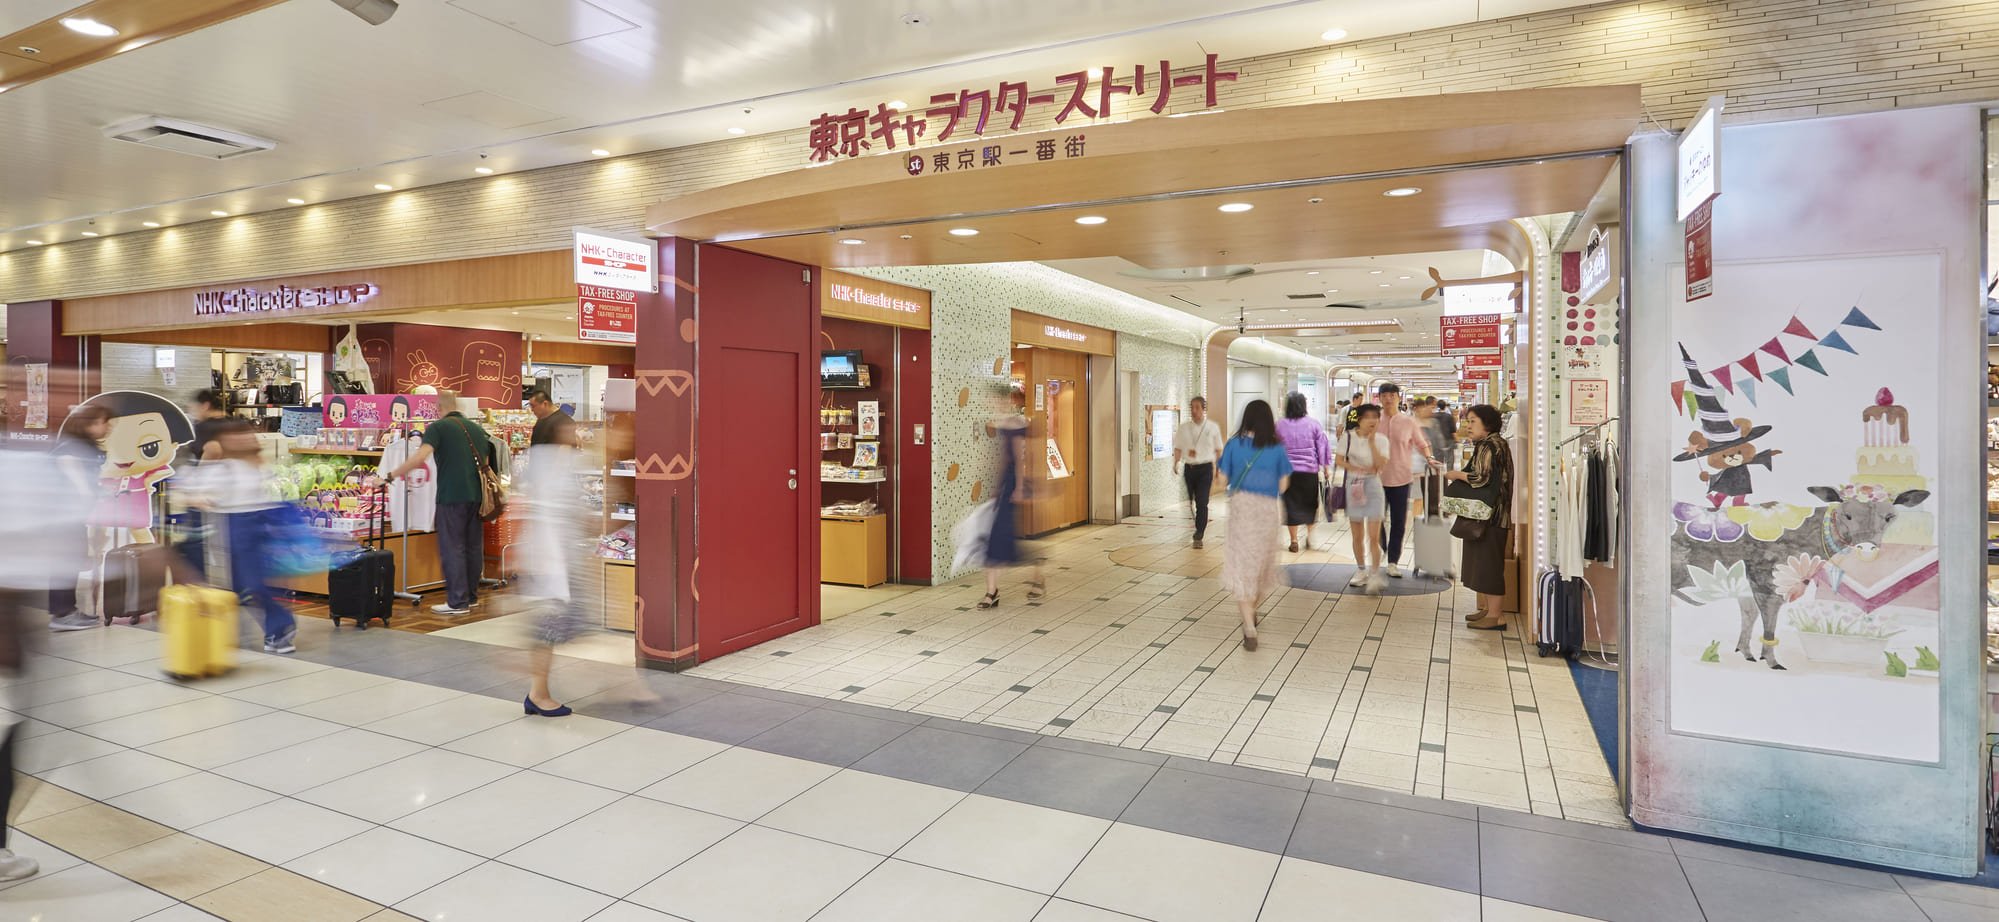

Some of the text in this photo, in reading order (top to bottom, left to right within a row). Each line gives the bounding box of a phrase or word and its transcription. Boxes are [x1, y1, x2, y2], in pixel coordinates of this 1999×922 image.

[809, 53, 1239, 162] 東京キャラクターストリート
[933, 134, 1086, 172] 東京駅一番街
[581, 243, 646, 262] NHK-Character
[580, 285, 635, 302] TAX-FREE SHOP
[1443, 315, 1499, 326] TAX-FREE SHOP
